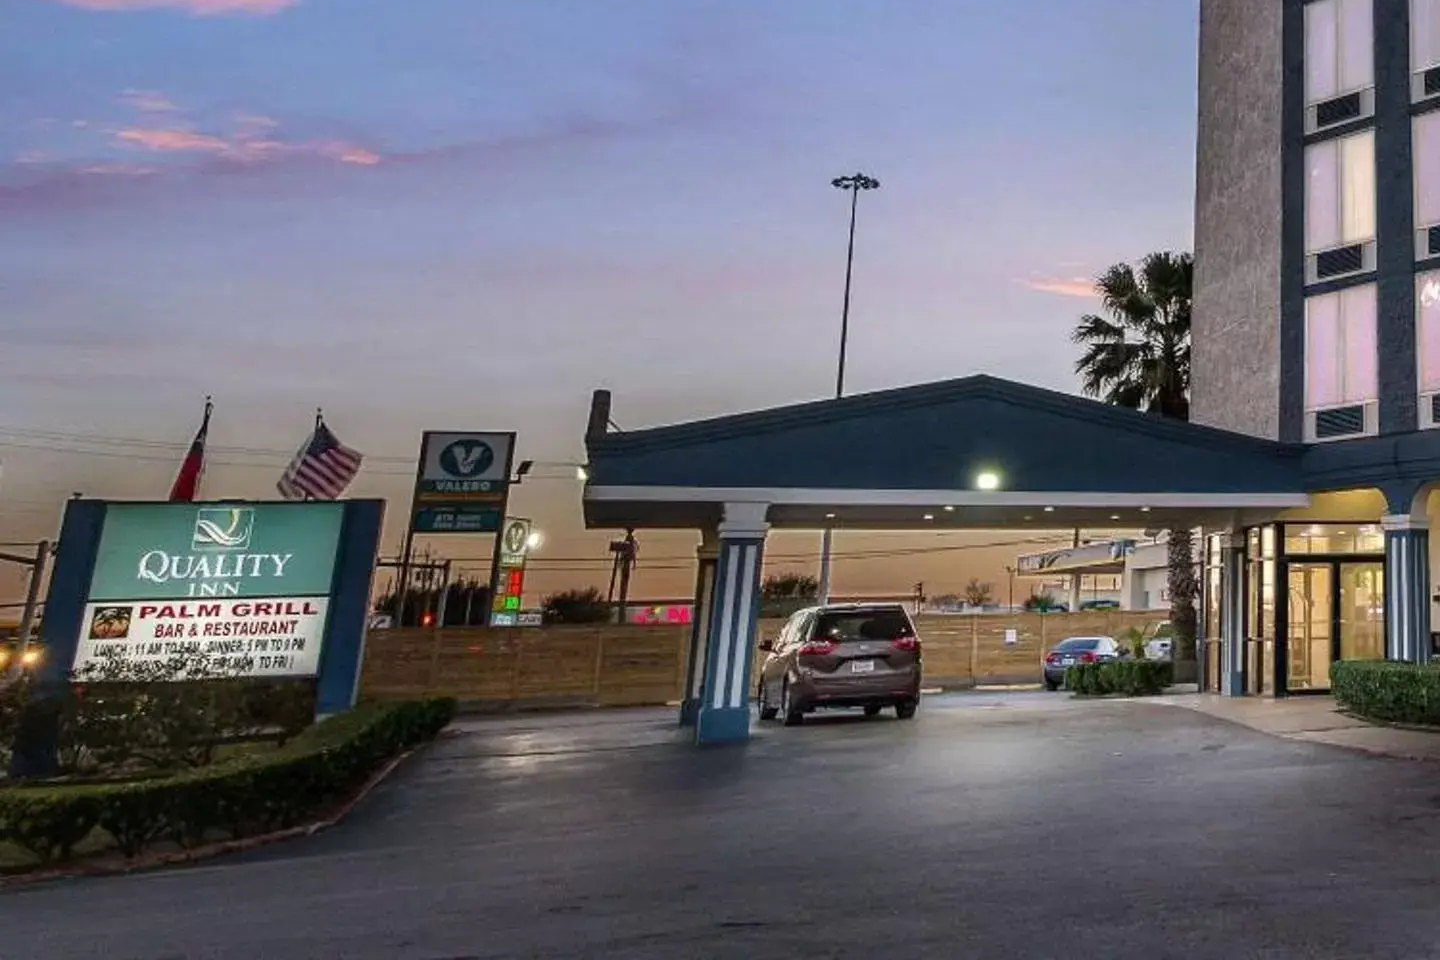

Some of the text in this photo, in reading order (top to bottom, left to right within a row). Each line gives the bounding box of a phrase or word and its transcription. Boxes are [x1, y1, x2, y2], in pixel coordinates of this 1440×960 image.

[436, 481, 491, 492] VALERO
[137, 550, 294, 583] QUALITY
[187, 581, 241, 597] INN
[139, 602, 318, 619] PALM GRILL
[154, 620, 299, 639] BAR & RESTAURANT
[260, 655, 273, 669] TO
